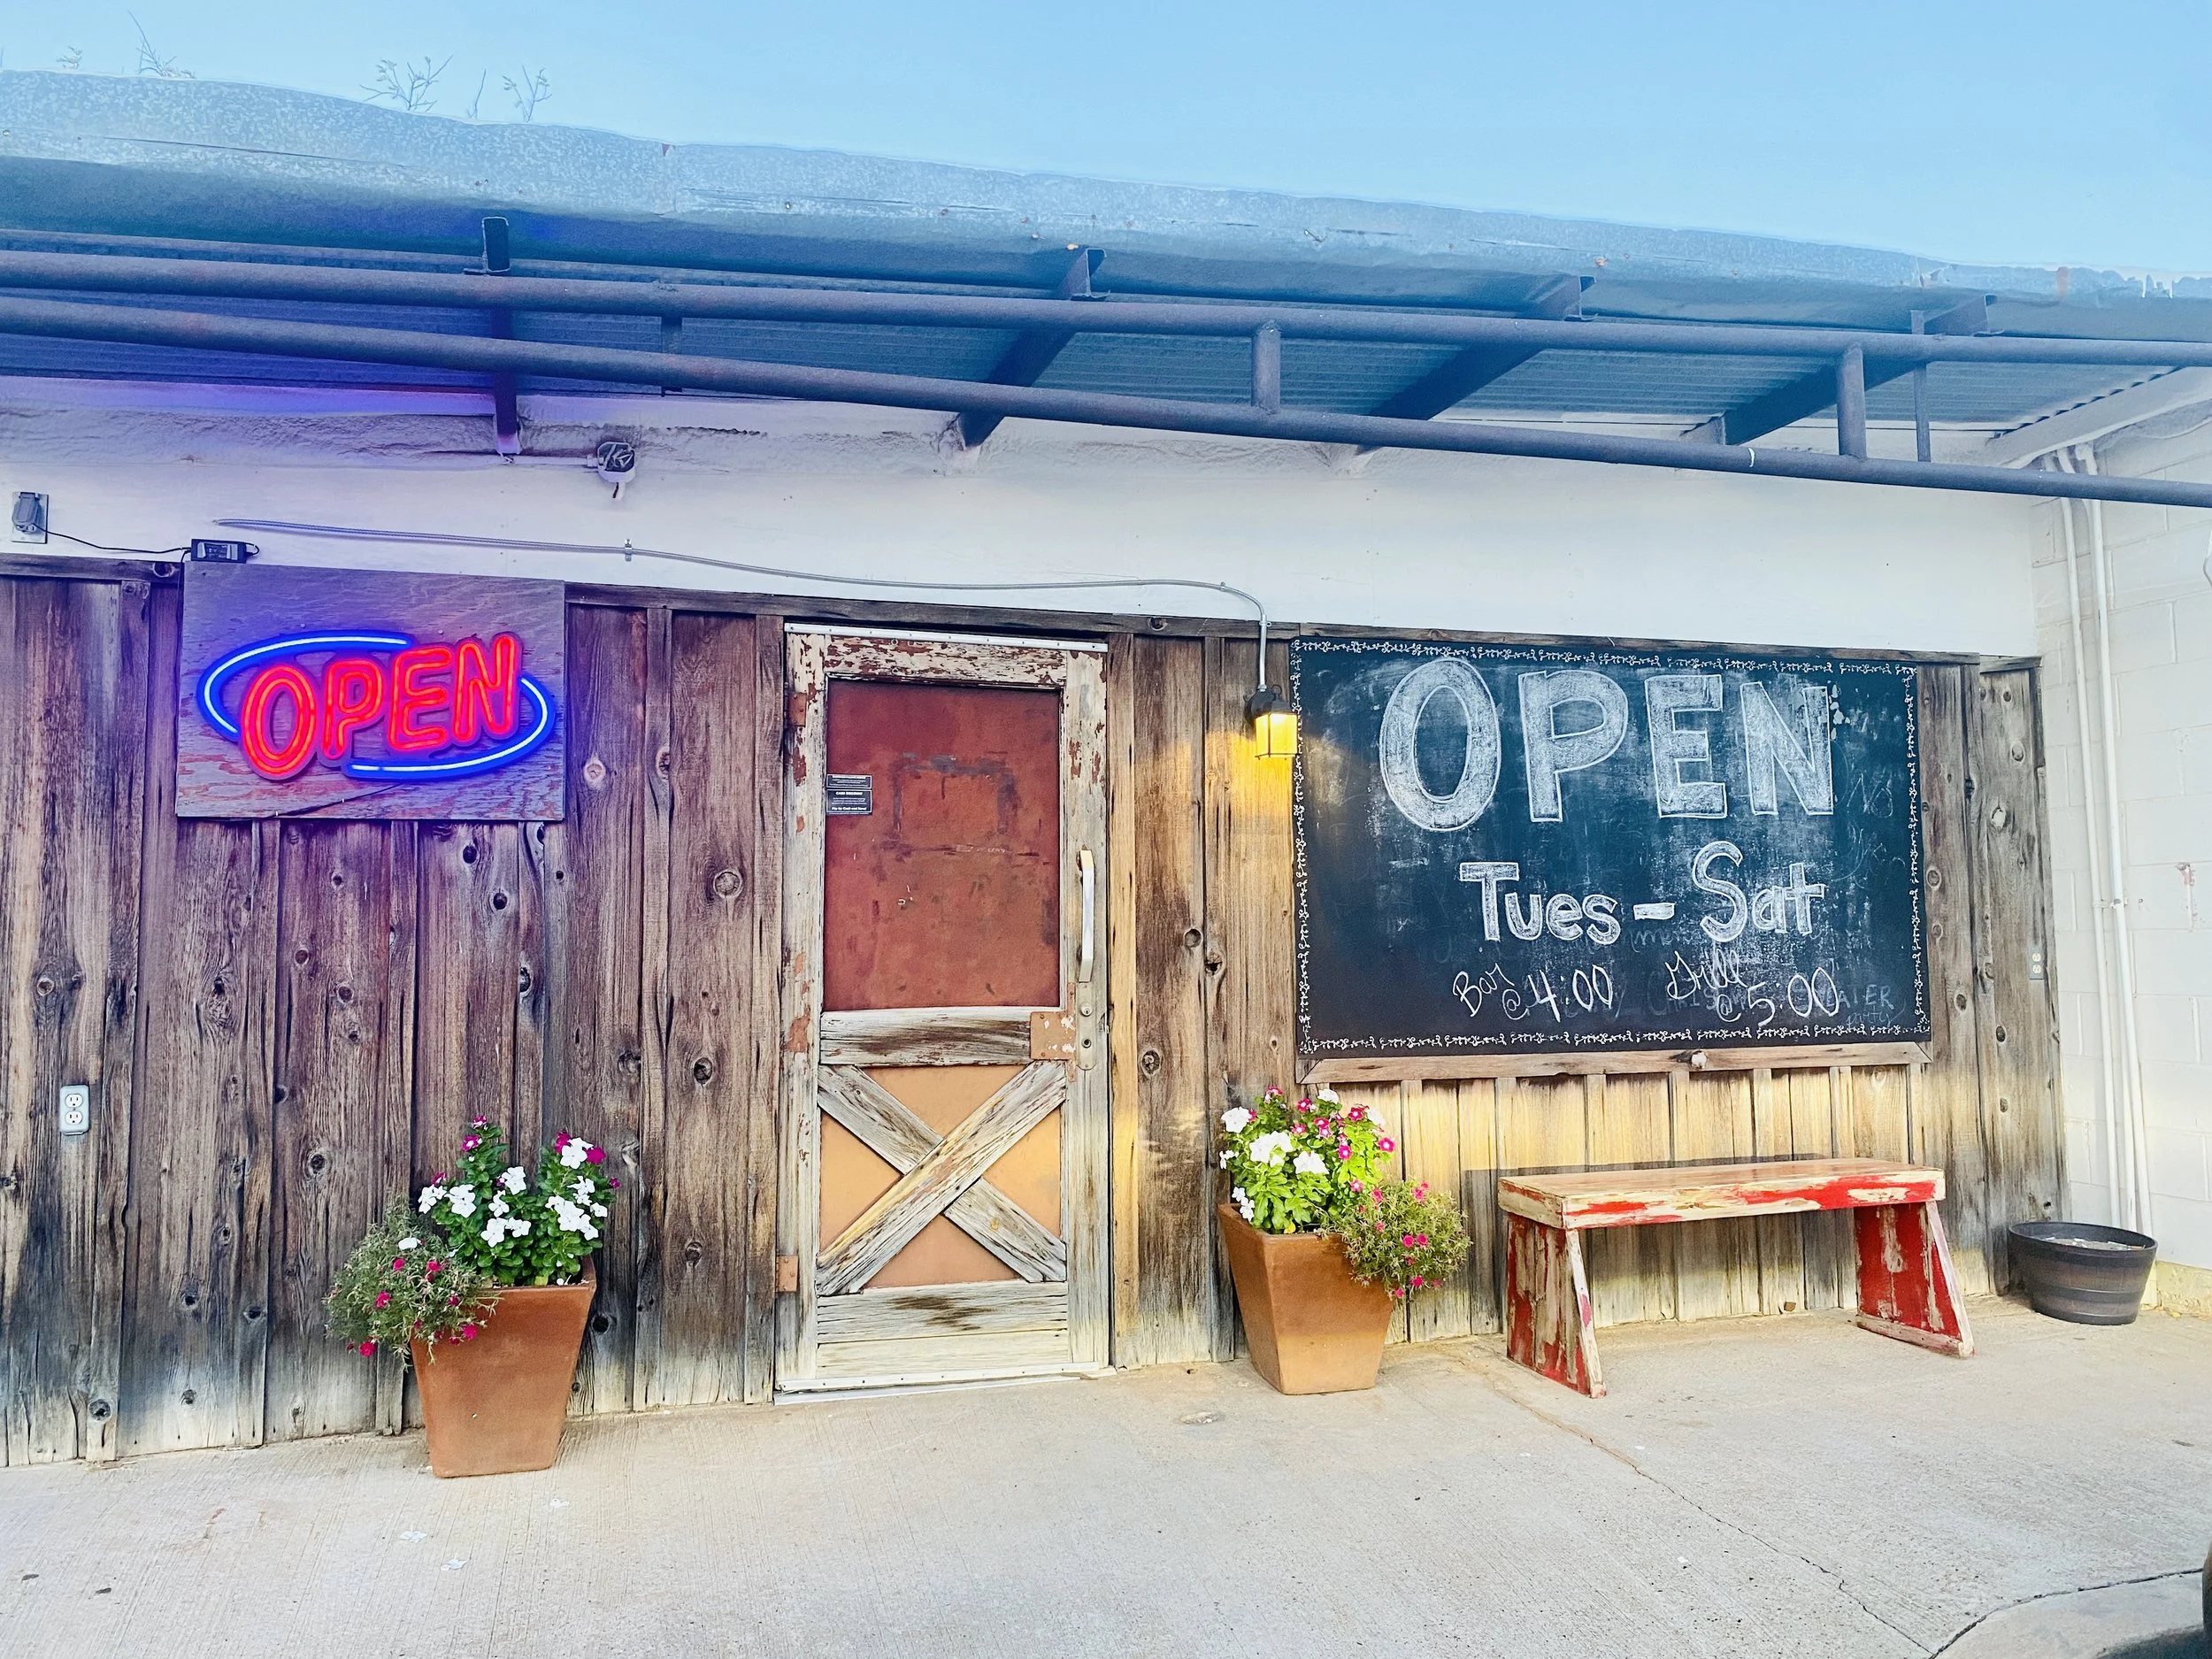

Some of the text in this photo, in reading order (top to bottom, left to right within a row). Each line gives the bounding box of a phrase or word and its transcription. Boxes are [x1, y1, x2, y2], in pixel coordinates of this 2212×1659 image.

[240, 633, 522, 780] OPEN
[1379, 657, 1833, 832] OPEN
[1459, 861, 1621, 946] Tues
[1691, 841, 1826, 943] Sat
[1453, 963, 1516, 1018] Bar
